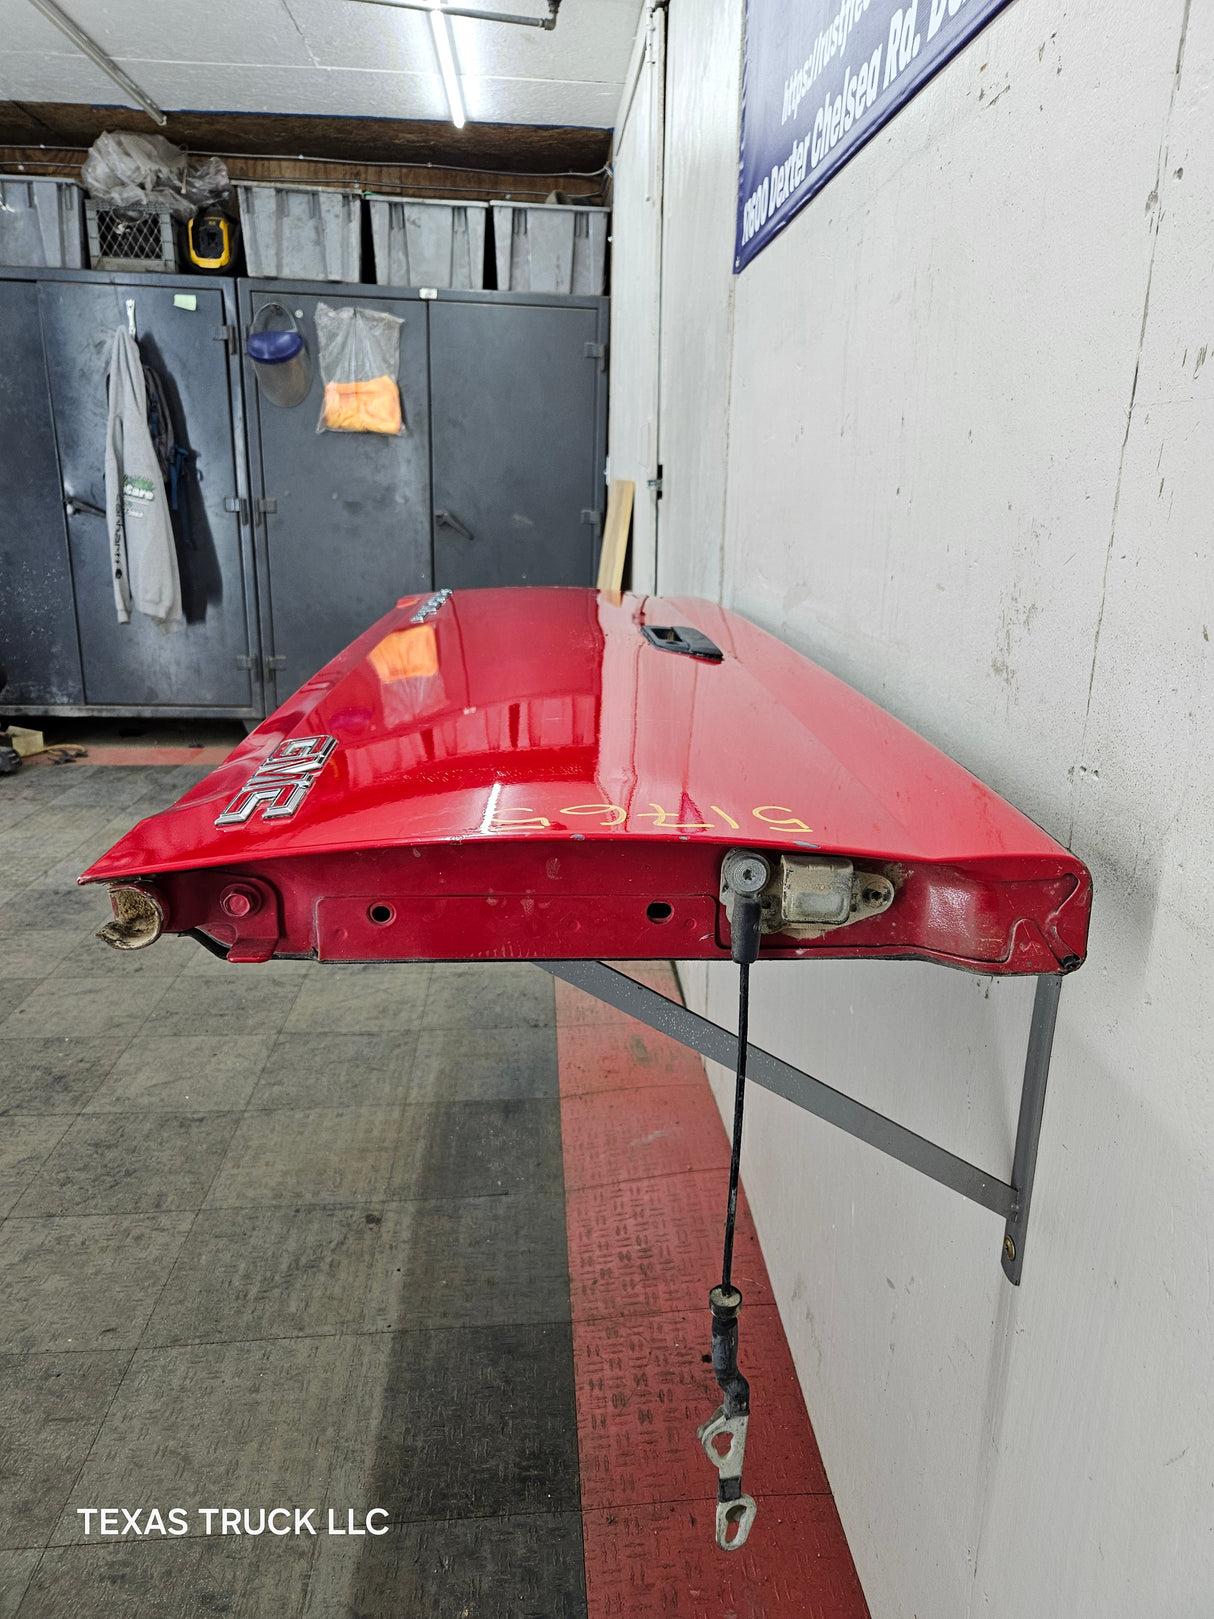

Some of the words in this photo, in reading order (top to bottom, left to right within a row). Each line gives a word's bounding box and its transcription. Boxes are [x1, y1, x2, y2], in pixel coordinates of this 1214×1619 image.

[768, 130, 811, 217] Dexter
[811, 43, 882, 168] Chelsea
[883, 0, 921, 90] Rd.
[214, 735, 338, 826] GMC
[490, 803, 813, 832] 51765
